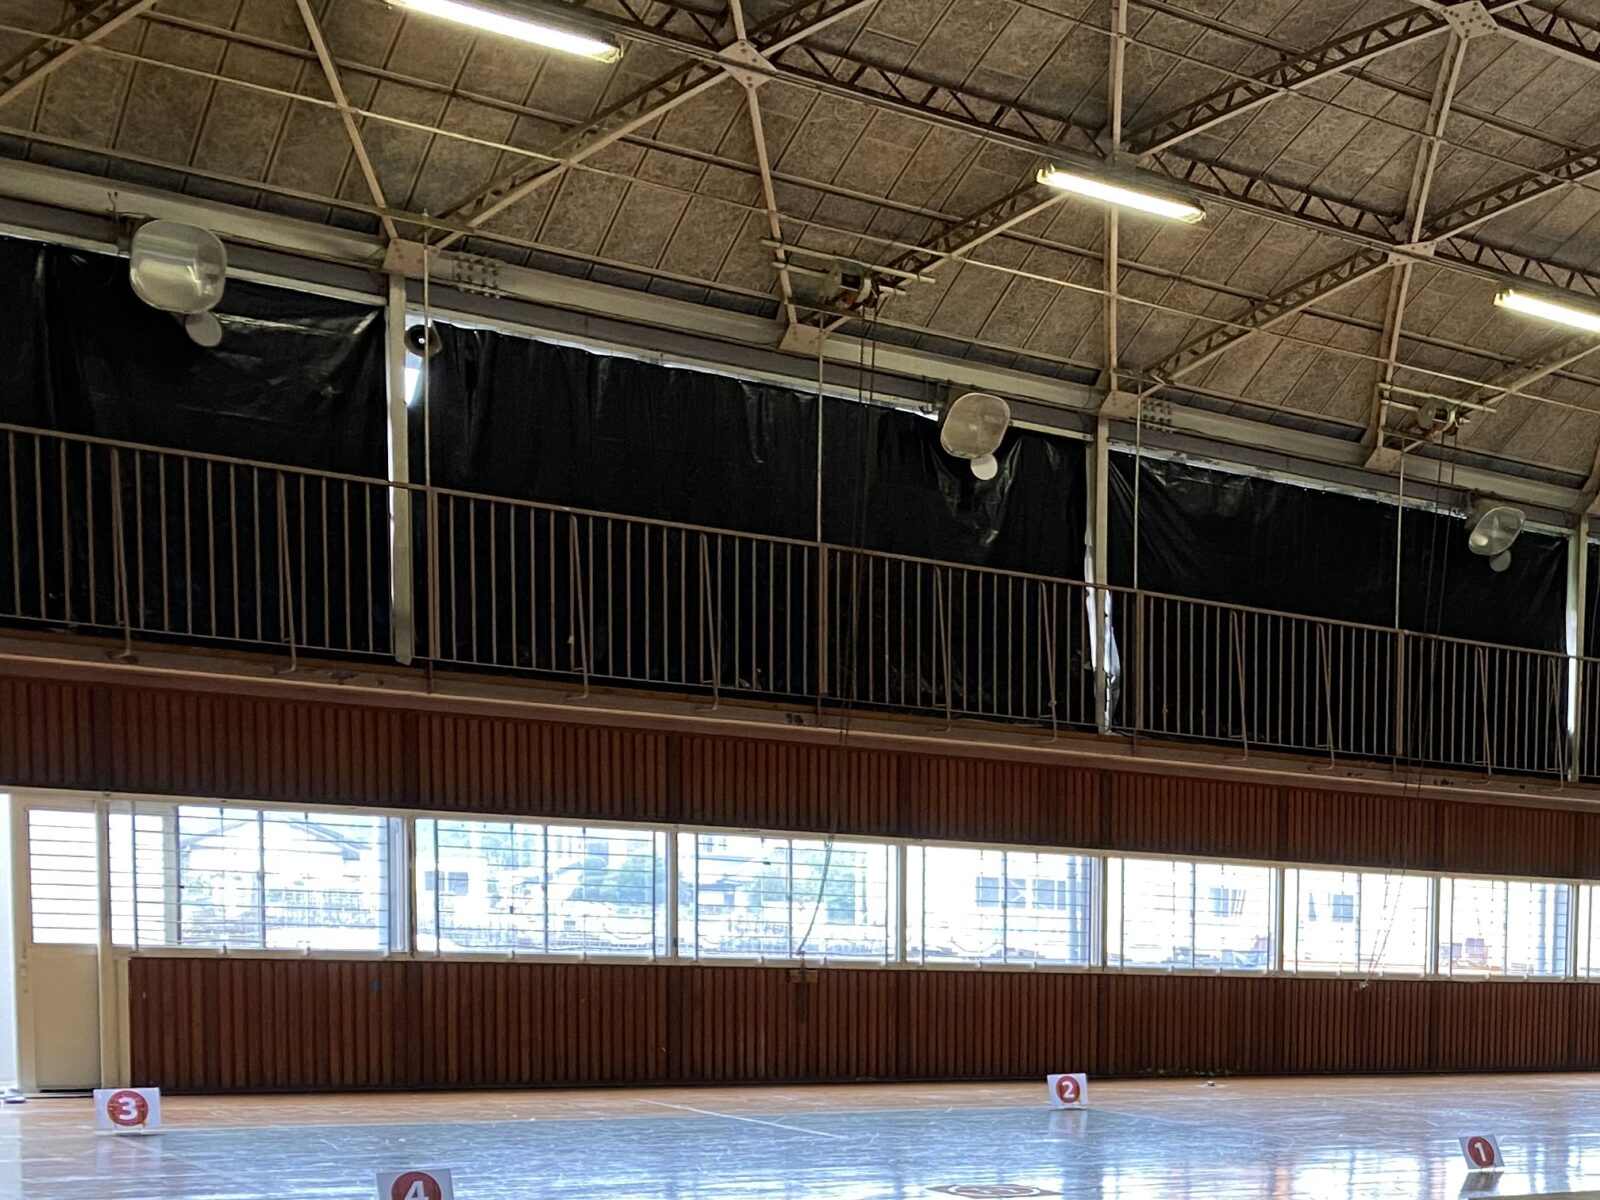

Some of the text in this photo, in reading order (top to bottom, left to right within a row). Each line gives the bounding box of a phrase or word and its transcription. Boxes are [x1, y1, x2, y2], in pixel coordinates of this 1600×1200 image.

[1061, 1080, 1075, 1099] 2
[118, 1096, 138, 1120] 3
[1474, 1142, 1487, 1162] 1
